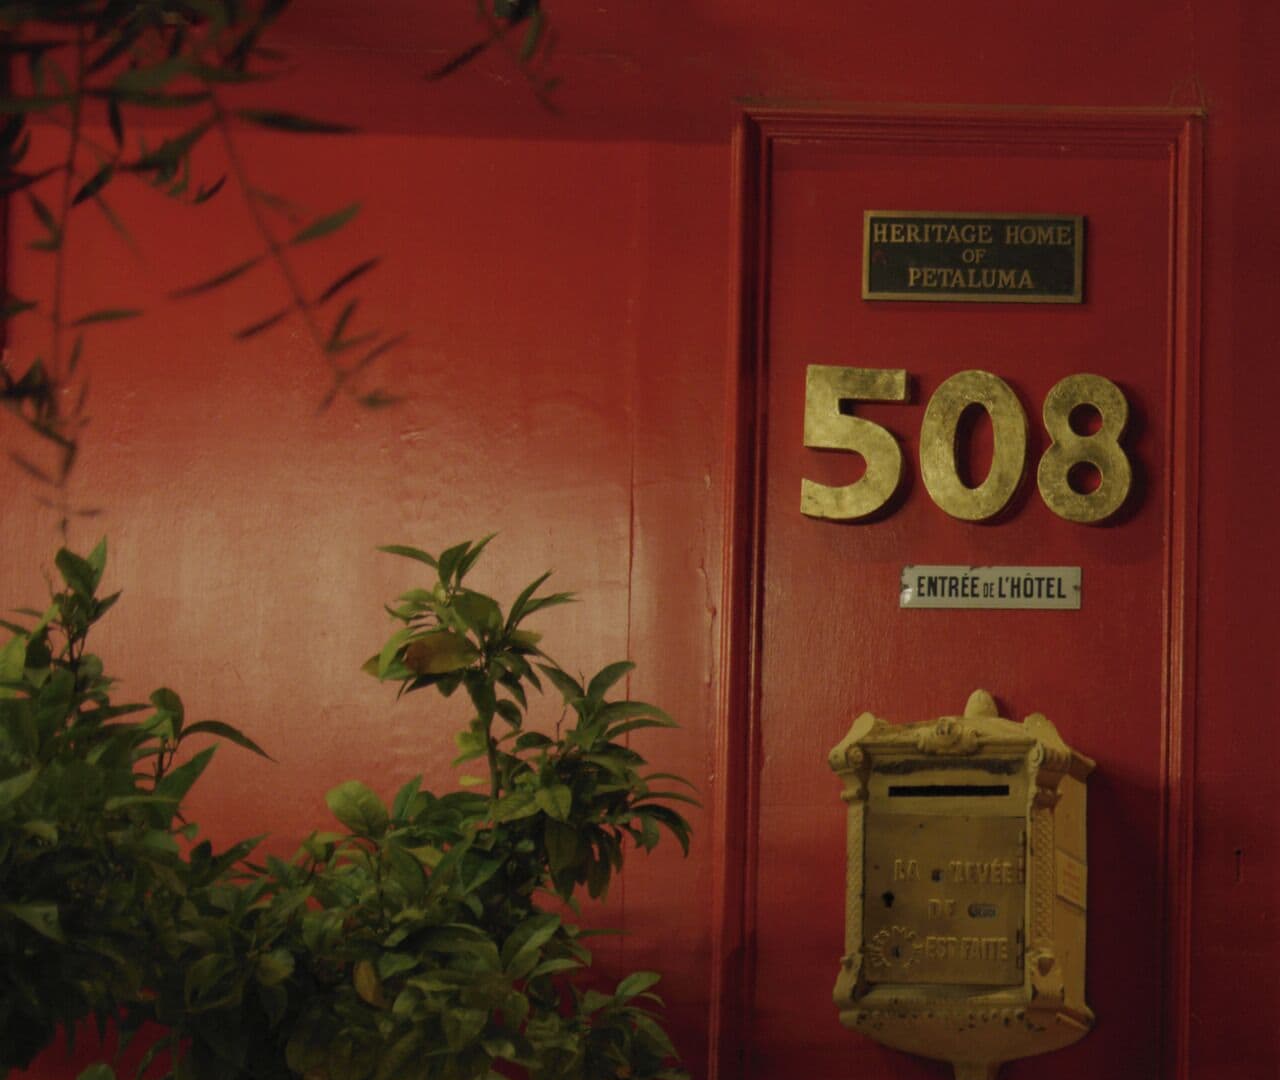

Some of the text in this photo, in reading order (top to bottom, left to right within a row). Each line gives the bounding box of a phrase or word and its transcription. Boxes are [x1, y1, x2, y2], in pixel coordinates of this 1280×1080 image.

[873, 223, 1072, 246] HERITAGE HOME
[962, 249, 986, 264] OF
[908, 268, 1034, 289] PETALUMA
[800, 364, 1132, 523] 508
[917, 571, 980, 598] ENTRÉE
[998, 572, 1067, 599] L'HÔTEL
